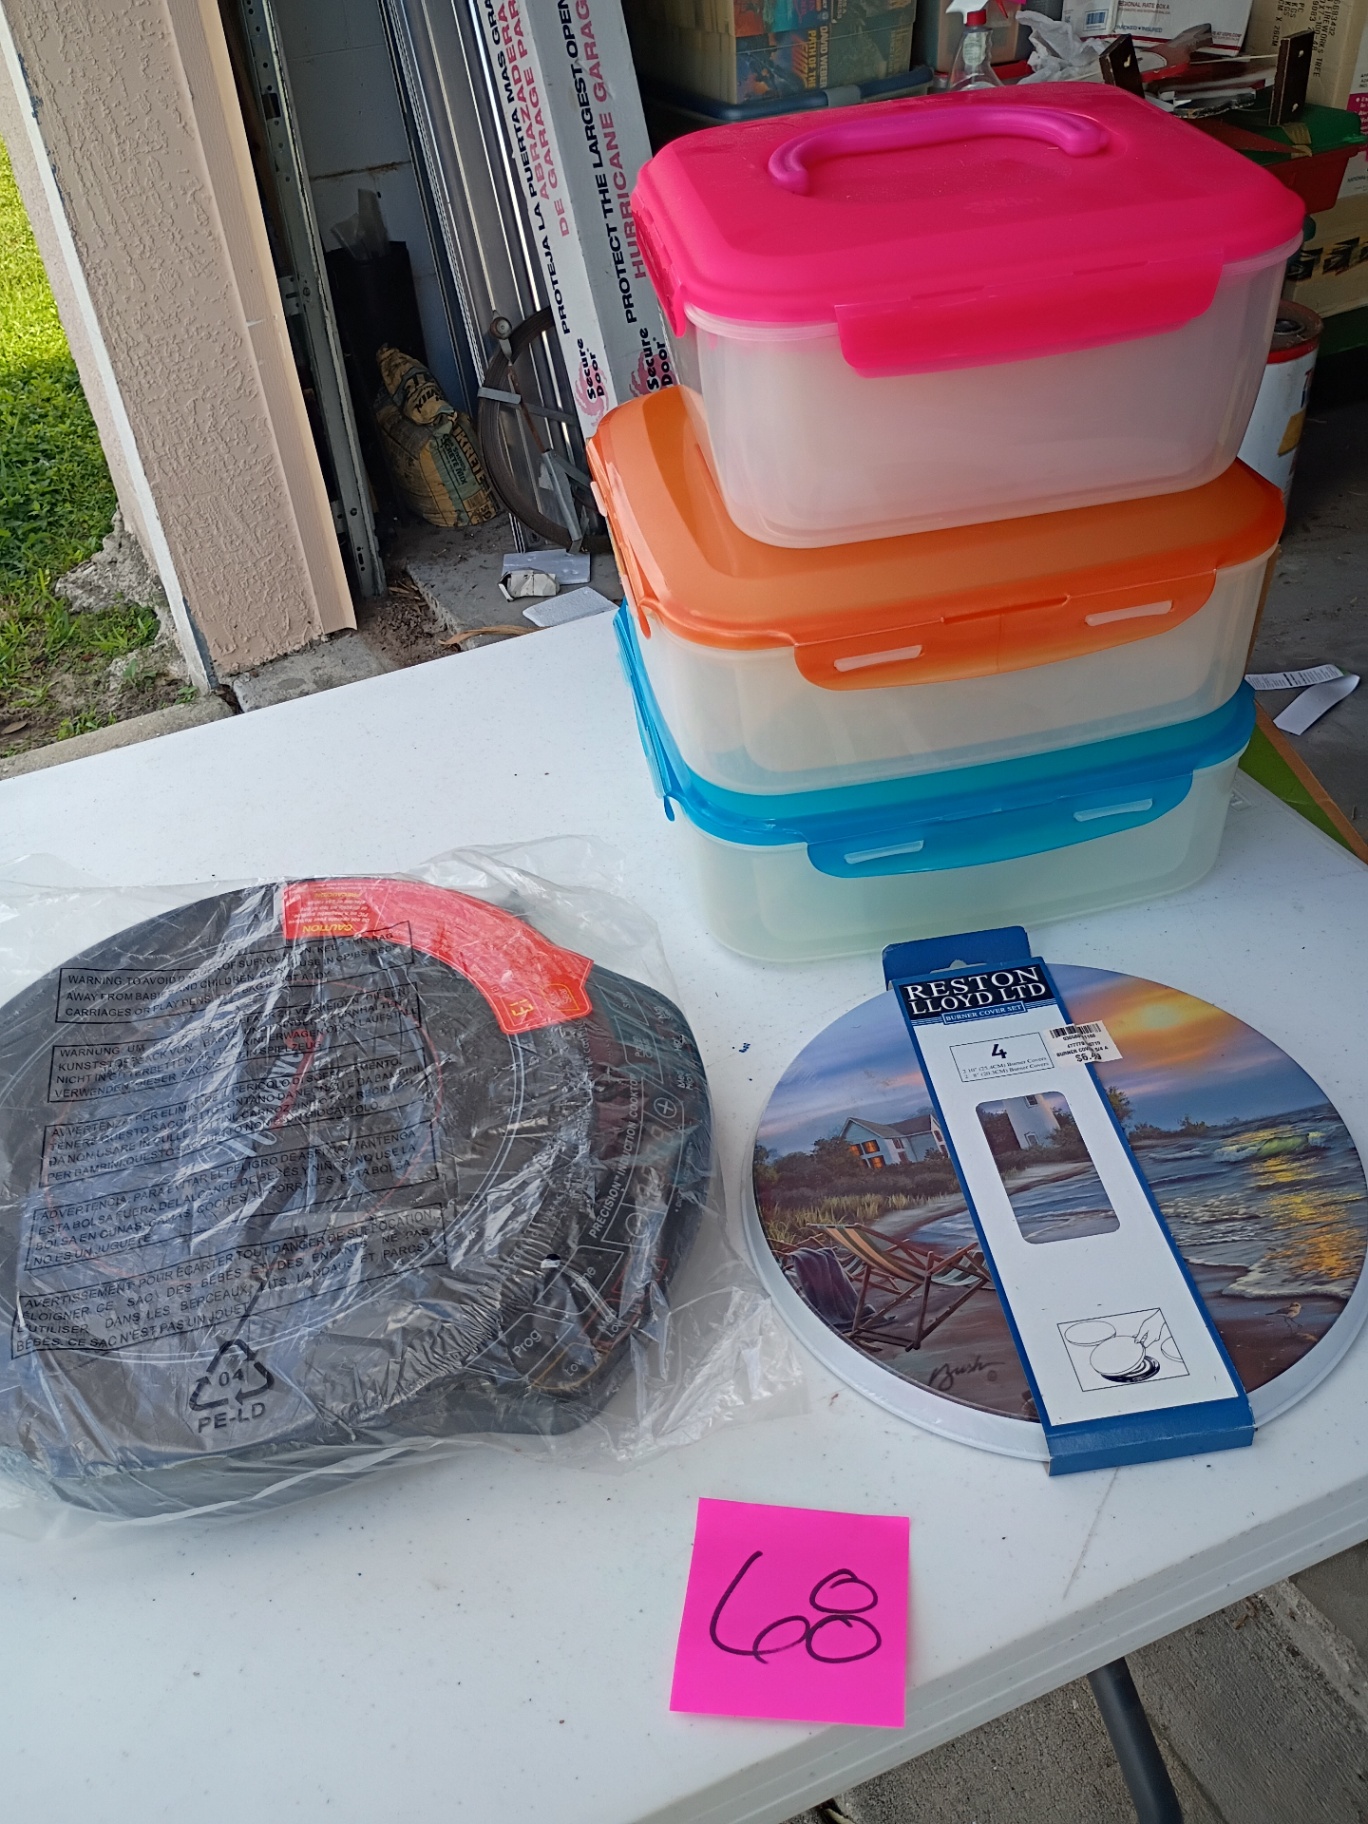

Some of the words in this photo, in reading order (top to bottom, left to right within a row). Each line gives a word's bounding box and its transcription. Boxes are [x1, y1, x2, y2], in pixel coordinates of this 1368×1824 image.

[1317, 6, 1332, 54] FIREWORKS
[499, 52, 516, 101] MAS
[819, 55, 829, 88] WEBER
[1313, 58, 1323, 78] TREE
[497, 4, 549, 200] ABRAZADERA
[571, 62, 604, 168] LARGEST
[523, 66, 561, 189] GARAGE
[511, 108, 537, 198] PUERTA
[594, 174, 616, 219] THE
[599, 111, 647, 278] HURRICANE
[534, 202, 547, 231] LA
[553, 198, 571, 236] DE
[542, 236, 571, 334] PROTEJA
[605, 224, 638, 323] PROTECT
[575, 338, 596, 400] Secure
[586, 349, 606, 397] Door
[638, 328, 660, 393] Secure
[651, 337, 674, 388] Door
[302, 923, 353, 934] CAUTION
[66, 992, 98, 1001] AWAY
[100, 992, 133, 1001] FROM
[68, 975, 122, 986] WARNING
[126, 976, 141, 986] TO
[141, 976, 178, 986] AVOID
[903, 966, 1039, 1000] RESTON
[910, 990, 994, 1015] LLOYD
[998, 981, 1047, 1001] LTD
[65, 1007, 132, 1017] CARRIAGES
[945, 1011, 978, 1022] BURNER
[979, 1007, 1005, 1018] COVER
[1007, 1004, 1022, 1012] SET
[60, 1046, 120, 1058] WARNUNG
[127, 1044, 145, 1053] UM
[991, 1043, 1007, 1059] 4
[1027, 1056, 1047, 1064] Covers
[1029, 1061, 1049, 1069] Covers
[56, 1074, 91, 1084] NICHT
[135, 1111, 158, 1124] PER
[232, 1077, 290, 1094] PERICOLO
[616, 1122, 640, 1177] INDUCTION
[38, 1222, 71, 1235] ESTA
[115, 1205, 157, 1221] FUERA
[158, 1199, 181, 1211] DEL
[240, 1174, 257, 1188] DE
[355, 1154, 373, 1164] NO
[375, 1149, 399, 1161] USE
[400, 1144, 416, 1154] LA
[47, 1170, 72, 1182] PER
[133, 1187, 169, 1201] PARA
[210, 1170, 224, 1181] EL
[226, 1156, 278, 1176] PELIGRO
[281, 1153, 297, 1165] DE
[79, 1232, 97, 1243] EN
[196, 1193, 247, 1214] COCHES
[340, 1168, 368, 1182] ESTA
[33, 1256, 52, 1267] NO
[74, 1248, 93, 1259] UN
[96, 1303, 114, 1314] CE
[166, 1283, 192, 1298] DES
[200, 1268, 242, 1288] BÉBÉS
[251, 1262, 266, 1274] ET
[277, 1256, 303, 1271] DES
[382, 1233, 400, 1244] NE
[138, 1270, 173, 1286] POUR
[176, 1253, 234, 1277] ÉCARTER
[236, 1247, 273, 1260] TOUT
[273, 1236, 328, 1254] DANGER
[329, 1233, 345, 1243] DE
[105, 1312, 140, 1329] DANS
[147, 1304, 171, 1319] LES
[297, 1260, 354, 1283] LANDAUS
[360, 1252, 376, 1263] ET
[382, 1244, 424, 1258] PARCS
[67, 1336, 86, 1347] CE
[92, 1335, 117, 1348] SAC
[120, 1325, 158, 1343] N'EST
[159, 1319, 184, 1332] PAS
[187, 1315, 206, 1328] UN
[513, 1328, 542, 1362] Prog
[218, 1369, 244, 1388] 04
[566, 1355, 585, 1377] Low
[198, 1402, 267, 1433] PE-LD
[709, 1550, 882, 1664] 68
